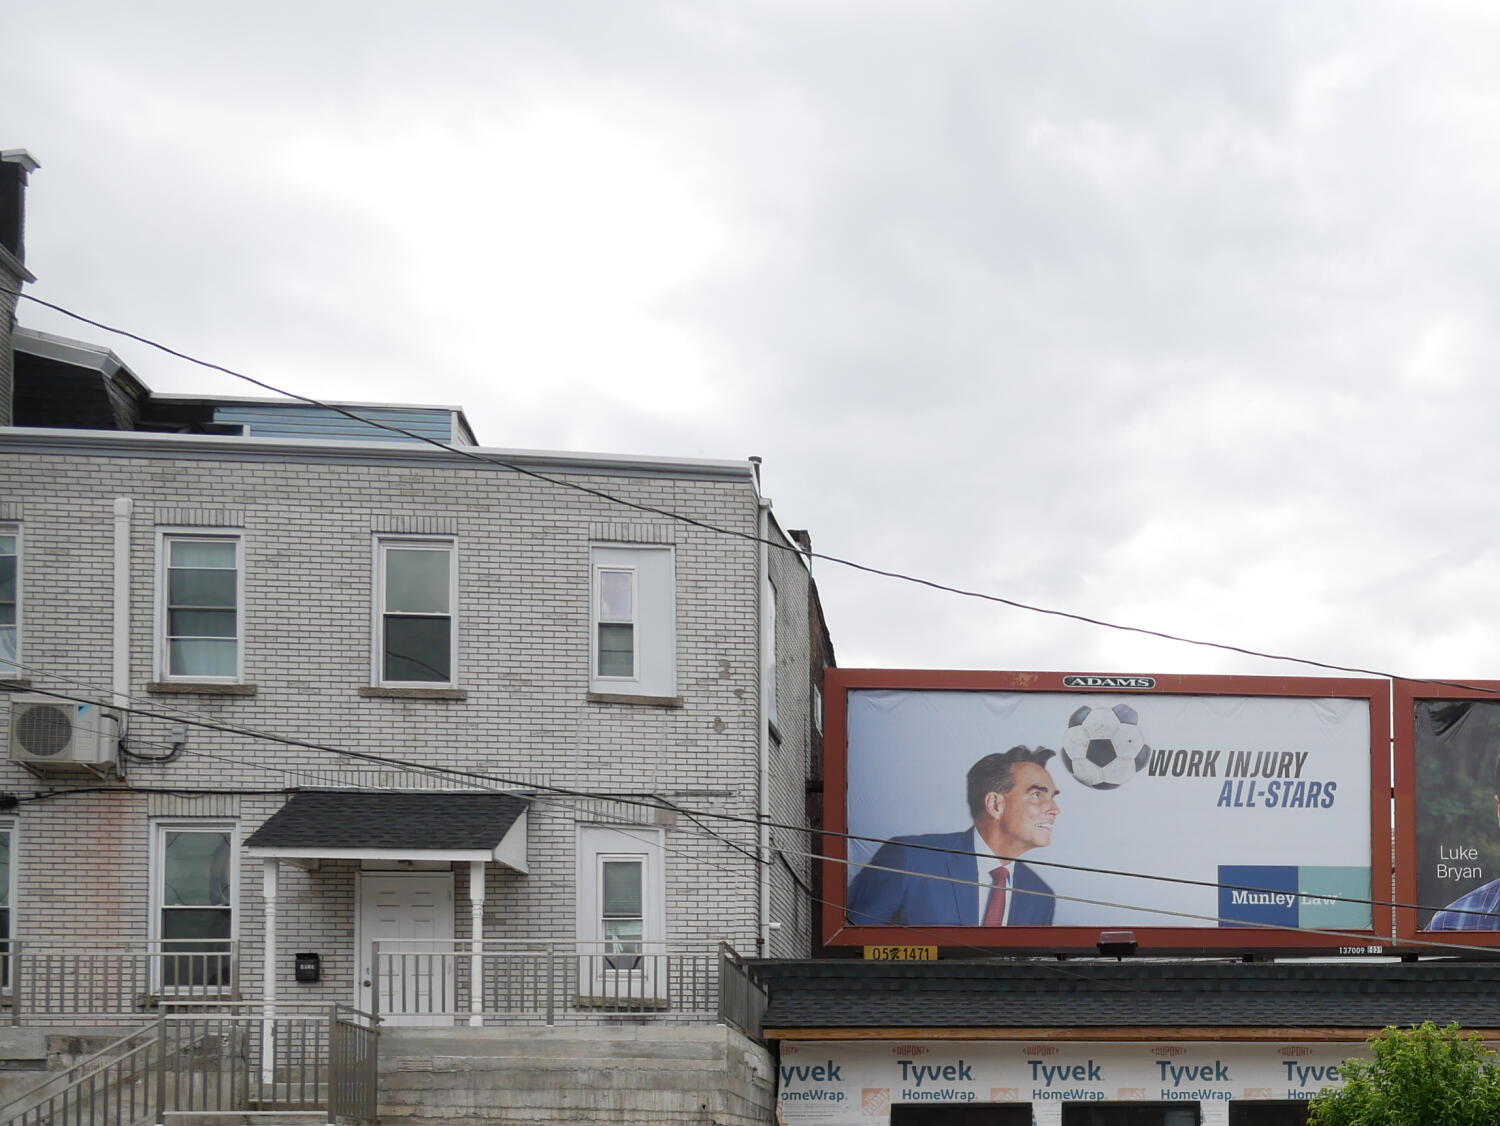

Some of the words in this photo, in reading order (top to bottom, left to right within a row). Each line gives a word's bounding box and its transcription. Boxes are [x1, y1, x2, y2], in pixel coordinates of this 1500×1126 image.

[1071, 677, 1149, 687] ADAMS
[1147, 749, 1221, 778] WORK
[1224, 750, 1309, 779] INJURY
[1216, 780, 1337, 809] ALL-STARS
[1440, 844, 1478, 860] Luke
[1437, 863, 1482, 882] Bryan
[1231, 890, 1296, 908] Munley
[1301, 891, 1338, 906] Law
[781, 1060, 842, 1088] yvek
[897, 1060, 972, 1087] Tyvek
[1027, 1060, 1102, 1087] Tyvek
[1156, 1060, 1229, 1086] Tyvek
[781, 1089, 844, 1102] omeWrap
[902, 1089, 976, 1102] HomeWrap
[1032, 1089, 1105, 1102] HomeWrap
[1161, 1089, 1232, 1101] HomeWrap
